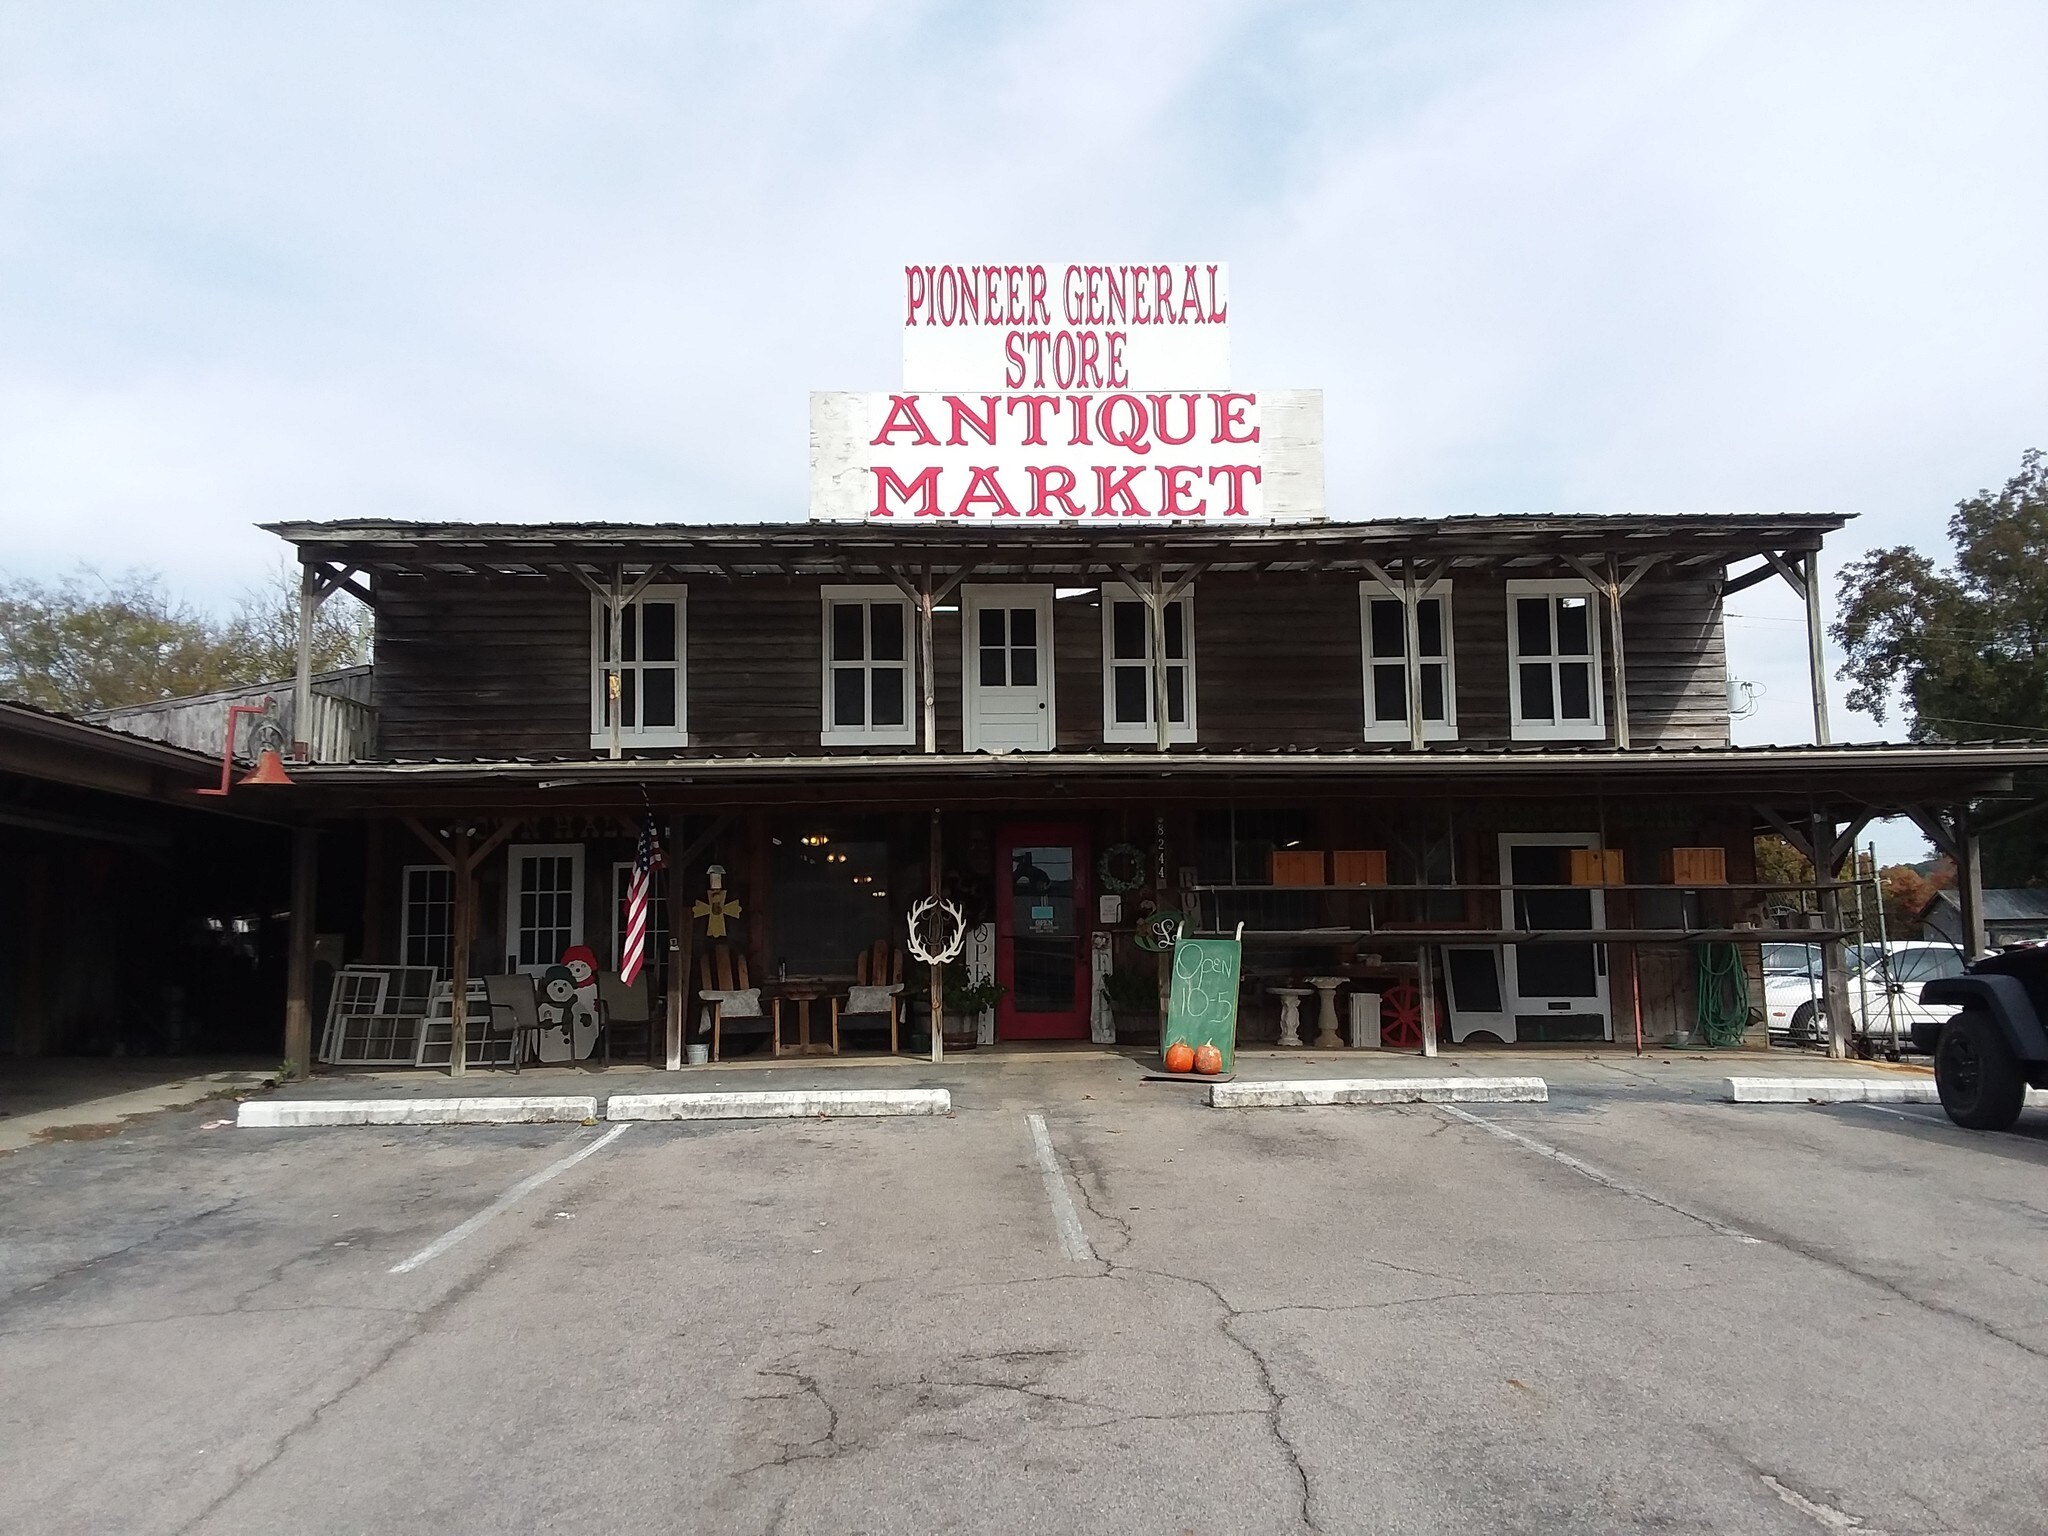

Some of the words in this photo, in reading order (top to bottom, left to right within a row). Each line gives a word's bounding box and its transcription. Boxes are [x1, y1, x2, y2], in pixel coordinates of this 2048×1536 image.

[905, 265, 1051, 326] PIONEER
[1065, 265, 1227, 326] GENERAL
[1005, 330, 1129, 389] STORE
[870, 393, 1261, 455] ANTIQUE
[870, 465, 1262, 518] MARKET
[1157, 823, 1165, 878] 8244
[1181, 987, 1232, 1023] 10-5
